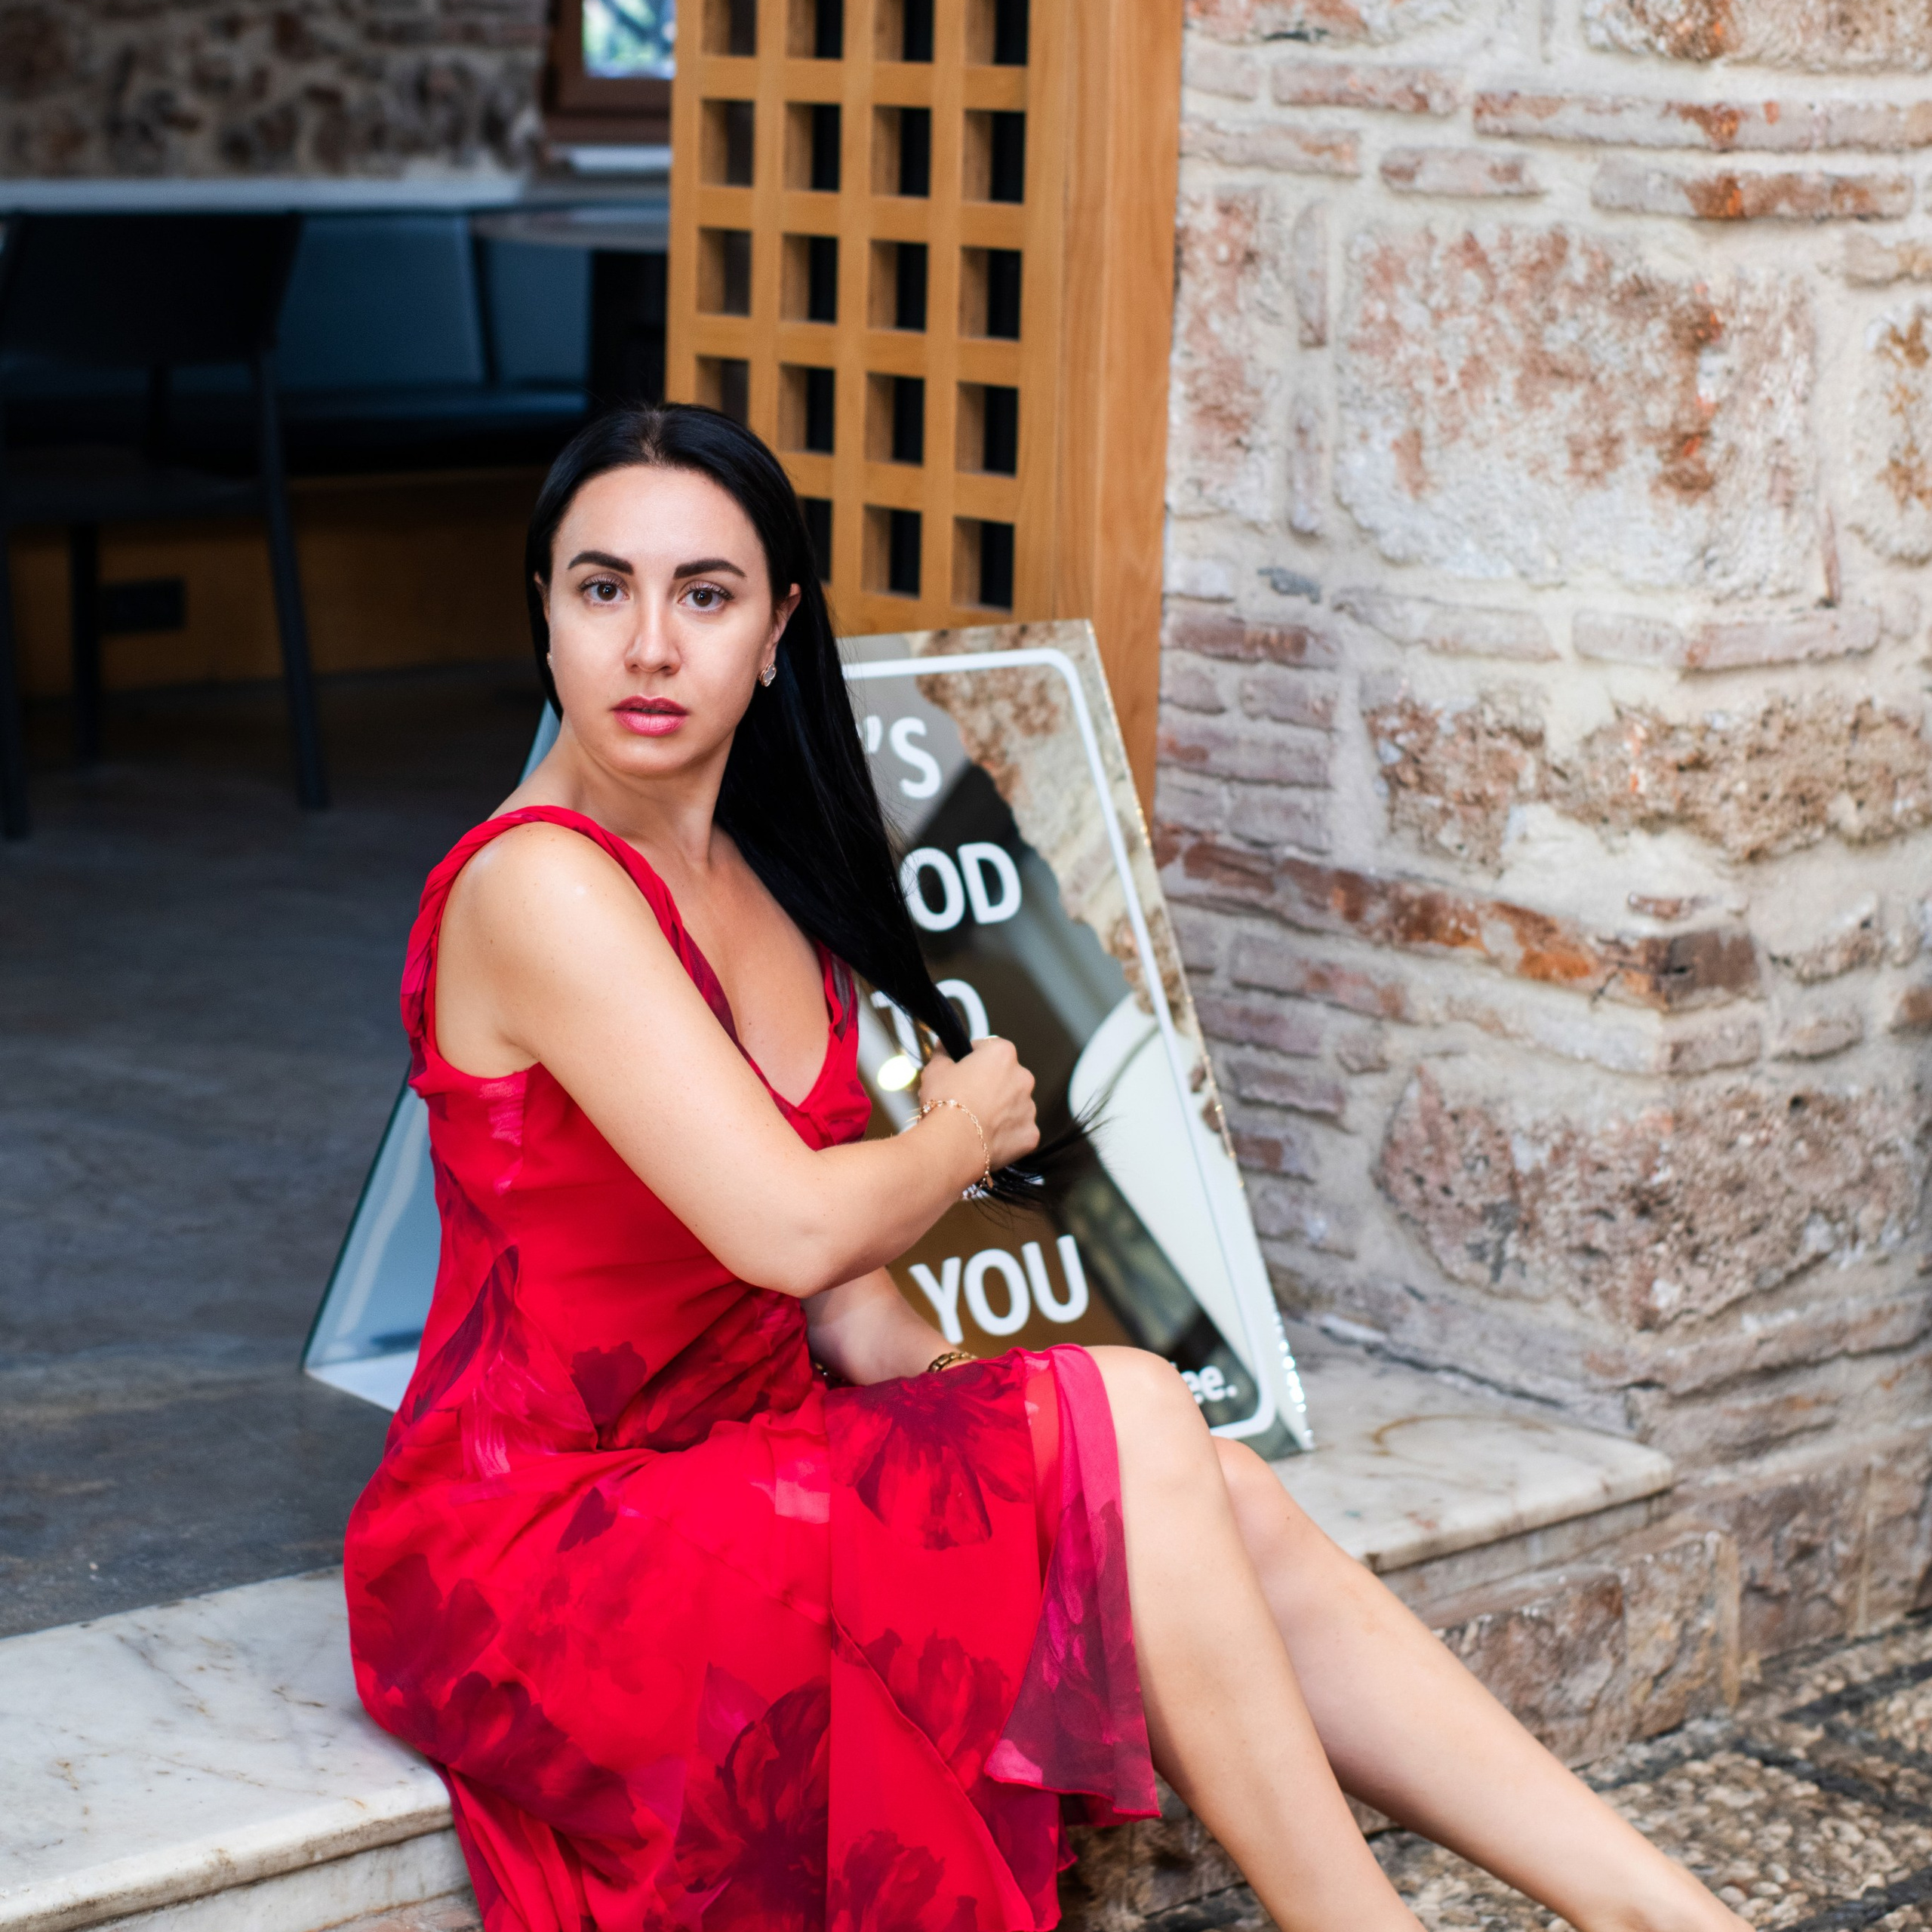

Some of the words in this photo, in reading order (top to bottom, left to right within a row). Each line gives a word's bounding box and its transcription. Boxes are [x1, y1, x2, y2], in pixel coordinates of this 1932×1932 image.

[855, 715, 941, 799] 'S
[900, 841, 1021, 931] OD
[908, 1233, 1089, 1345] YOU
